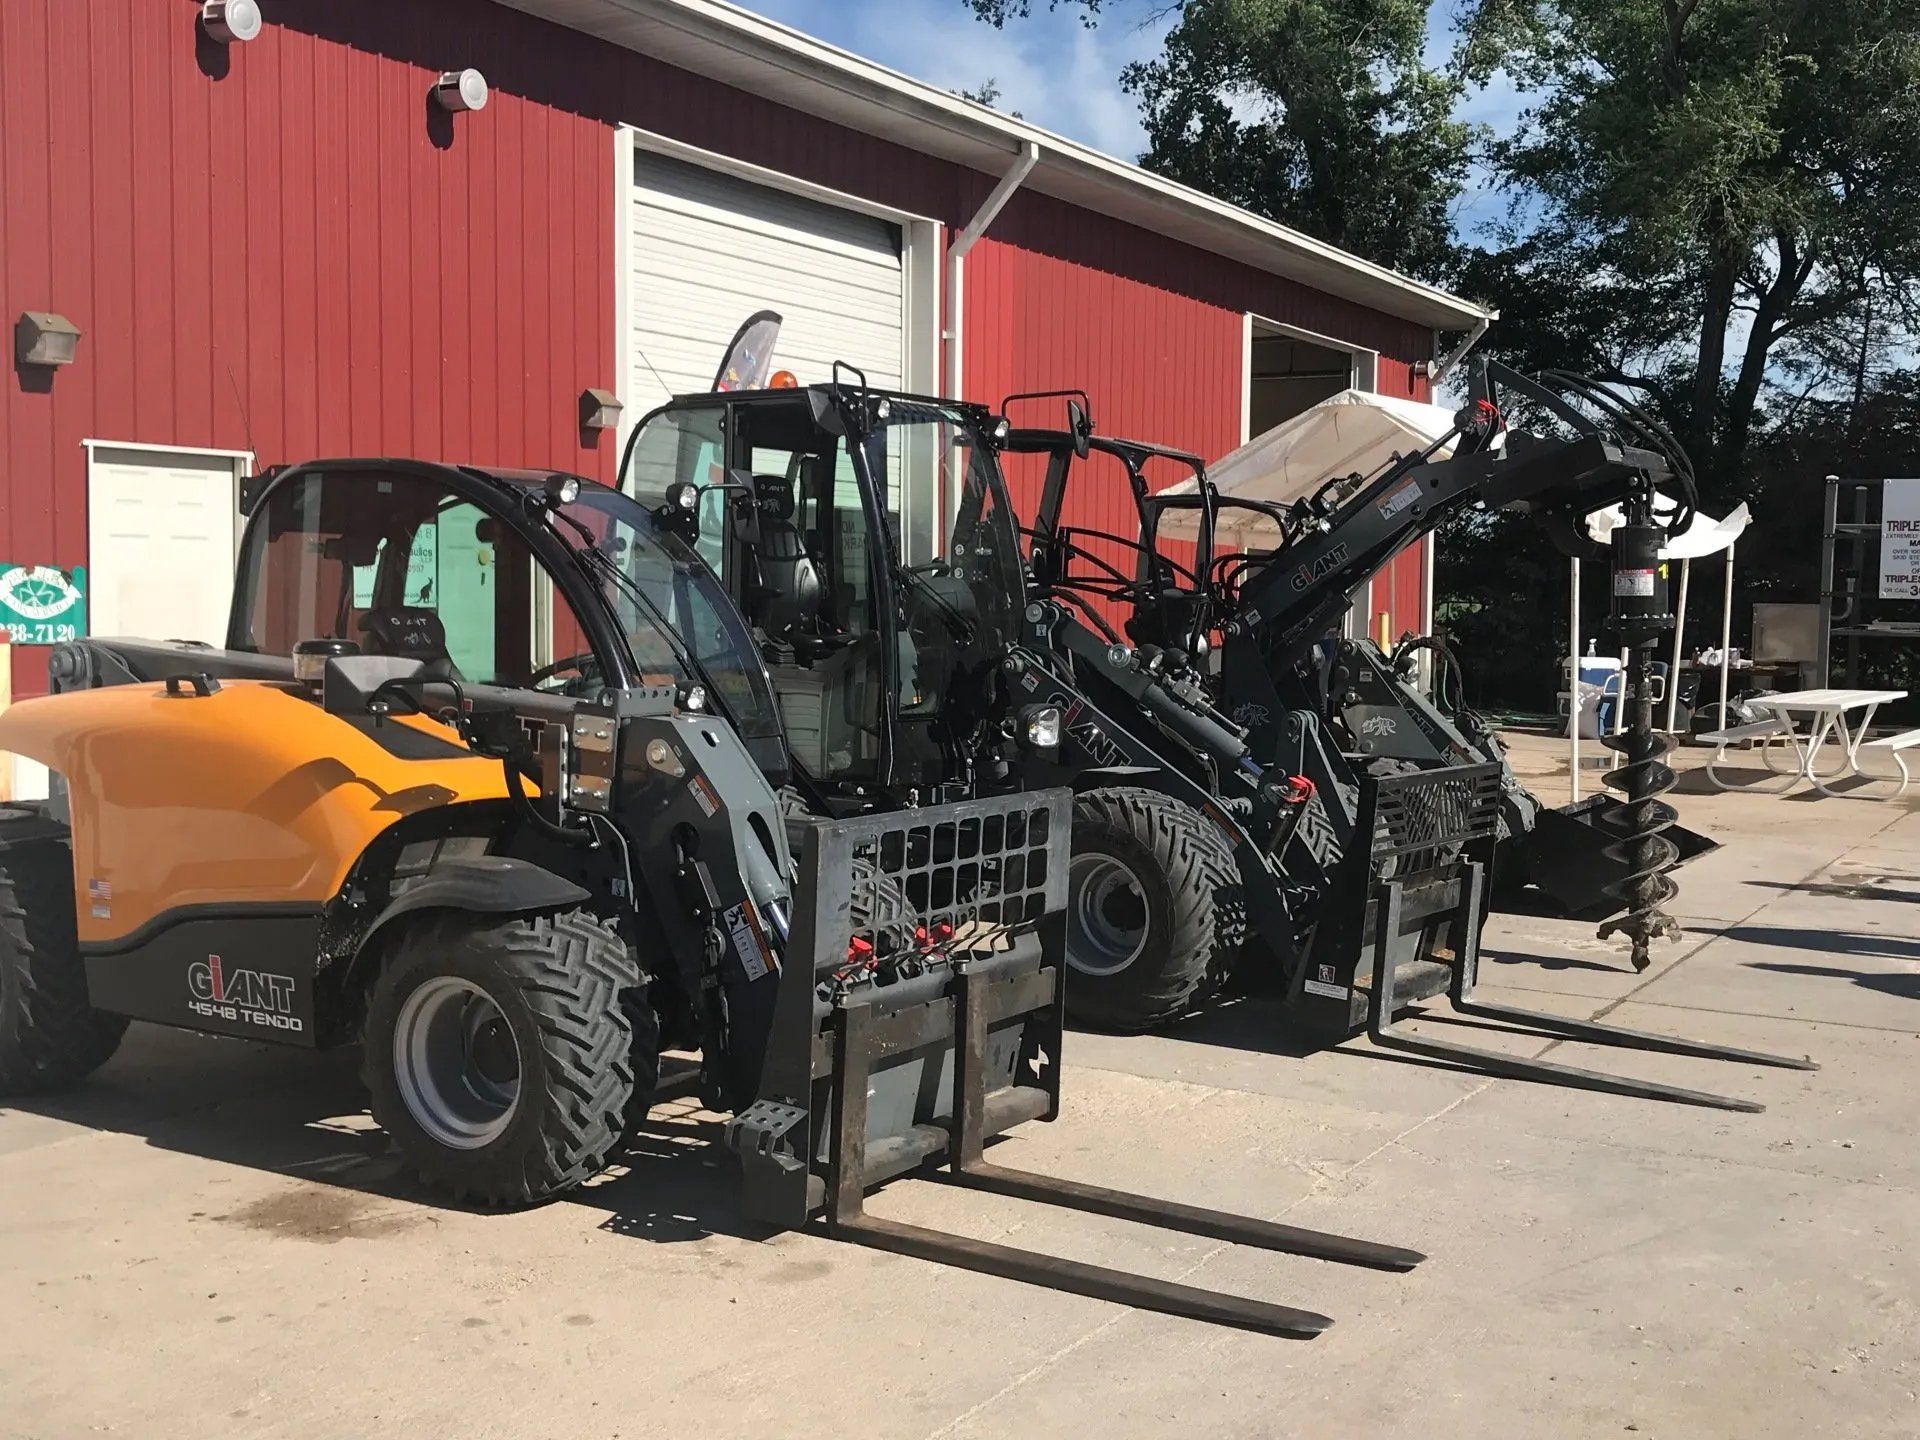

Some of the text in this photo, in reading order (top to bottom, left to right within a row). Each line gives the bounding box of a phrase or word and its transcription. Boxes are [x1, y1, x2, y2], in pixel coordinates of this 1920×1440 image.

[1290, 541, 1349, 591] GiANT
[1910, 586, 1920, 596] 3
[187, 953, 296, 1014] GiANT
[188, 1000, 303, 1031] 4548 TENDO
